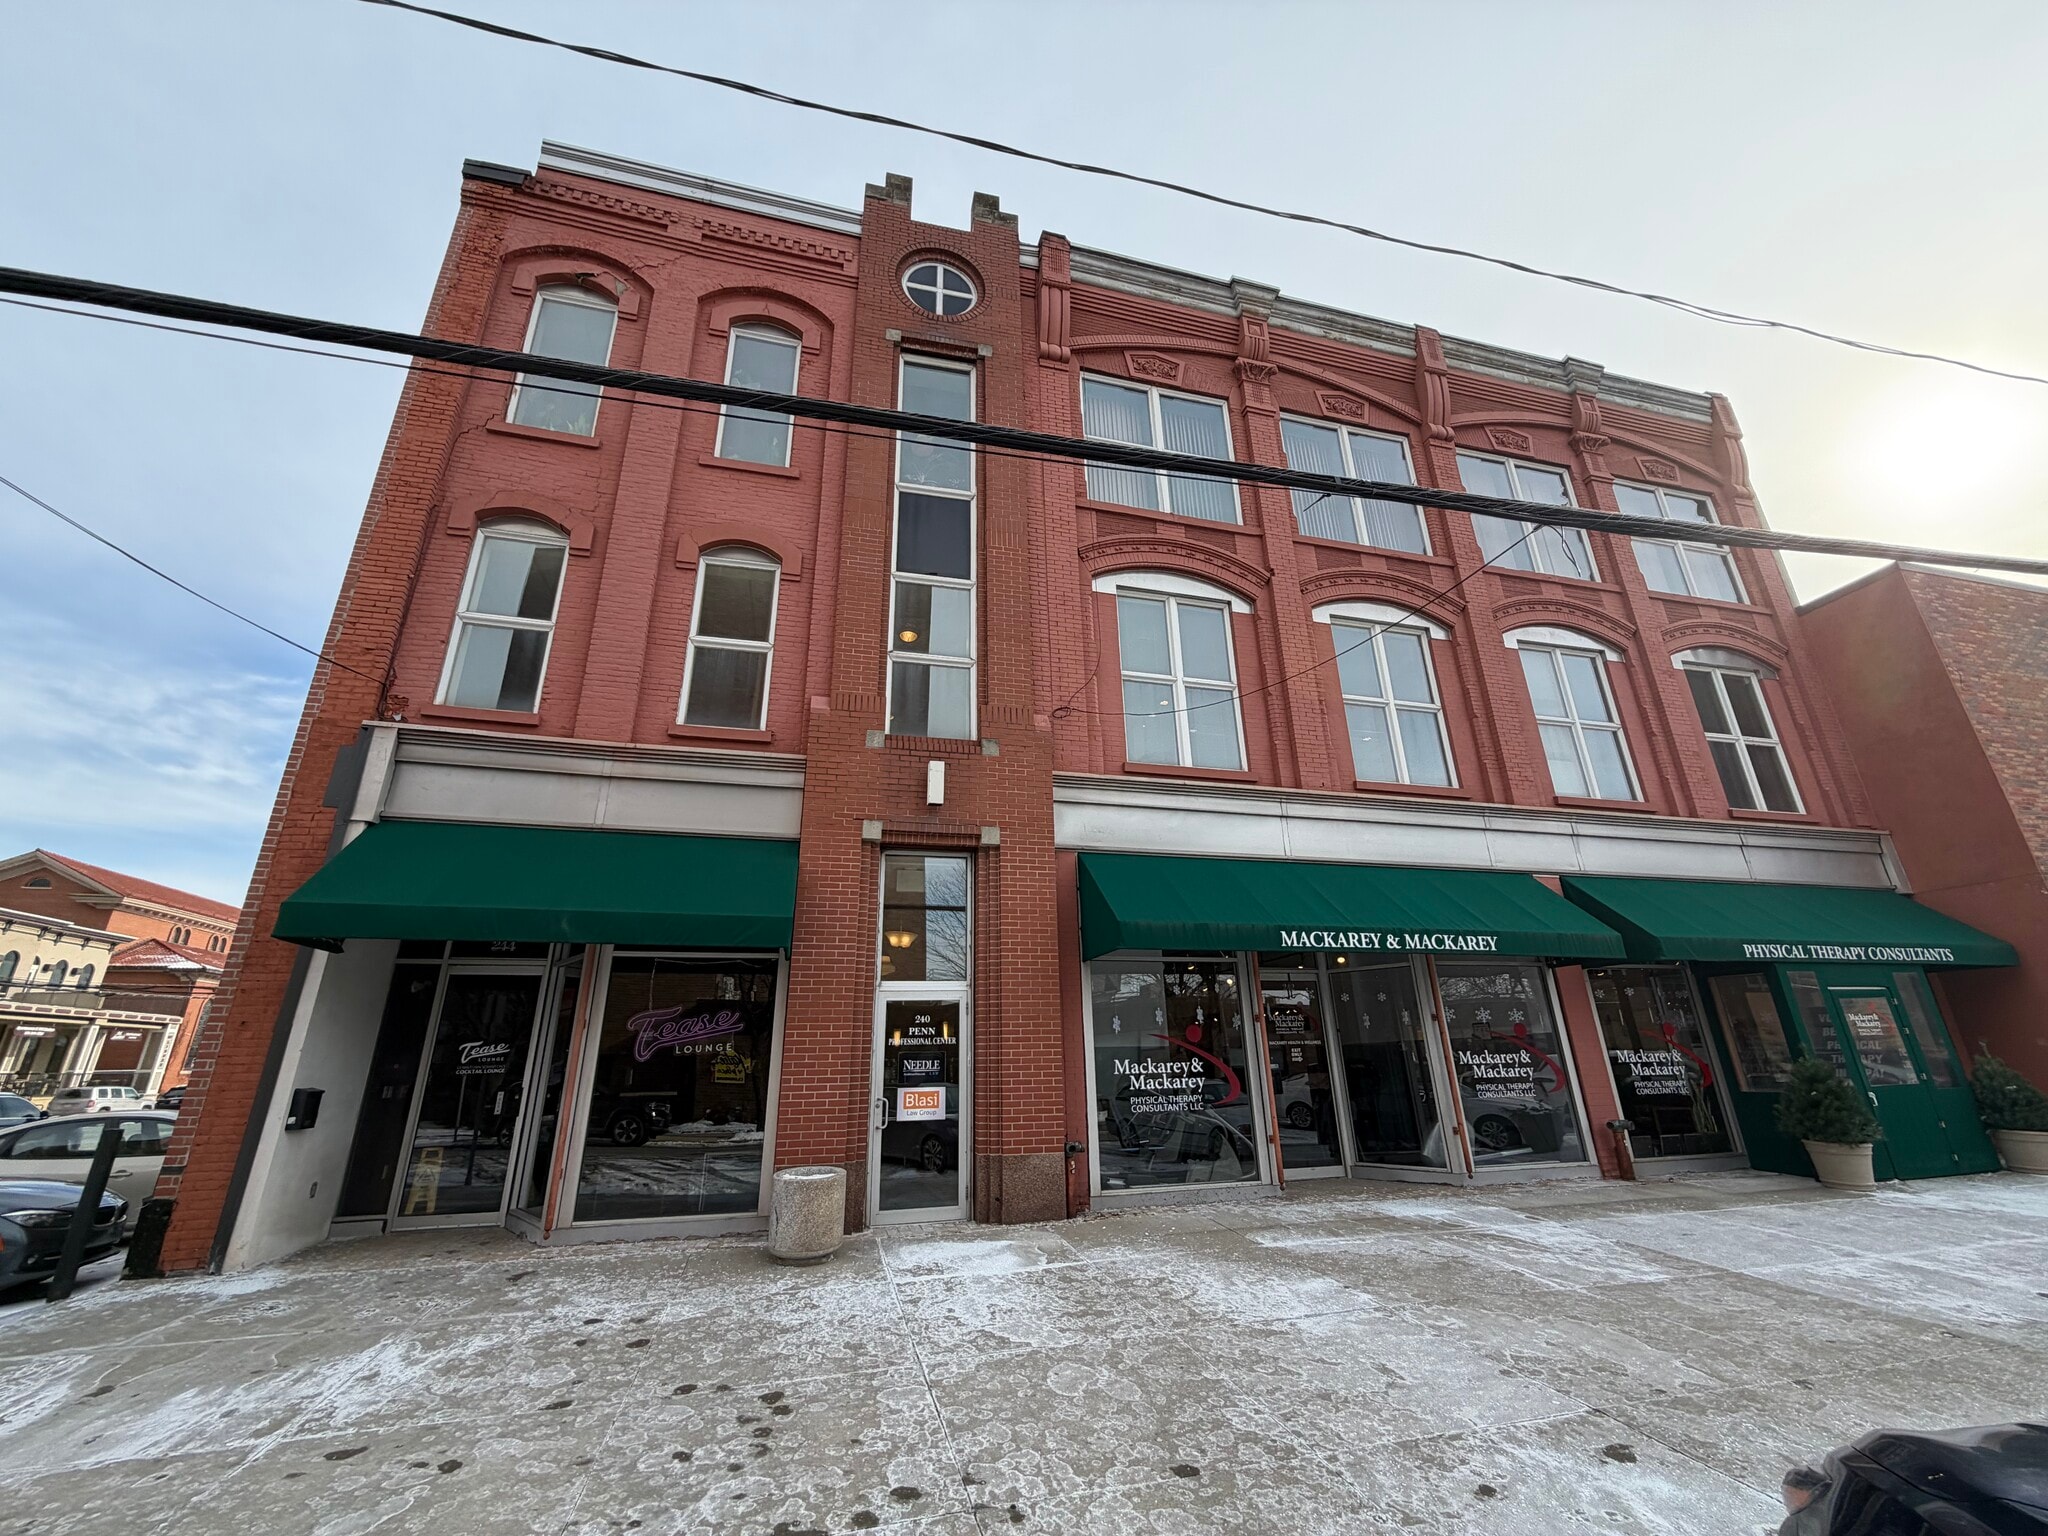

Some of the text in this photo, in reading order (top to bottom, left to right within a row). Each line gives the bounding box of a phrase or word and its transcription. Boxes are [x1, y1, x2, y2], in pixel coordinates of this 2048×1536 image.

[1280, 930, 1498, 951] MACKAREY & MACKAREY
[1742, 944, 1954, 962] PHYSICAL THERAPY CONSULTANTS
[914, 1014, 931, 1023] 240
[627, 1006, 744, 1062] Tease
[908, 1027, 936, 1036] PENN
[888, 1037, 957, 1046] PROFESSIONAL CENTER
[458, 1040, 511, 1064] Tease
[675, 1042, 733, 1054] LOUNGE
[903, 1059, 941, 1070] NEEDLE
[1472, 1063, 1534, 1081] Mackarey
[1629, 1062, 1686, 1079] Mackarey
[1129, 1073, 1205, 1093] Mackarey
[1475, 1083, 1506, 1091] PHYSICAL
[1477, 1089, 1537, 1098] CONSULTANTS LLC
[1635, 1086, 1690, 1095] CONSULTANTS LLC
[905, 1093, 938, 1107] Blasi
[1130, 1094, 1203, 1105] PHYSICAL THERAPY
[919, 1109, 937, 1117] Group
[1131, 1102, 1204, 1113] CONSULTANTS LLC
